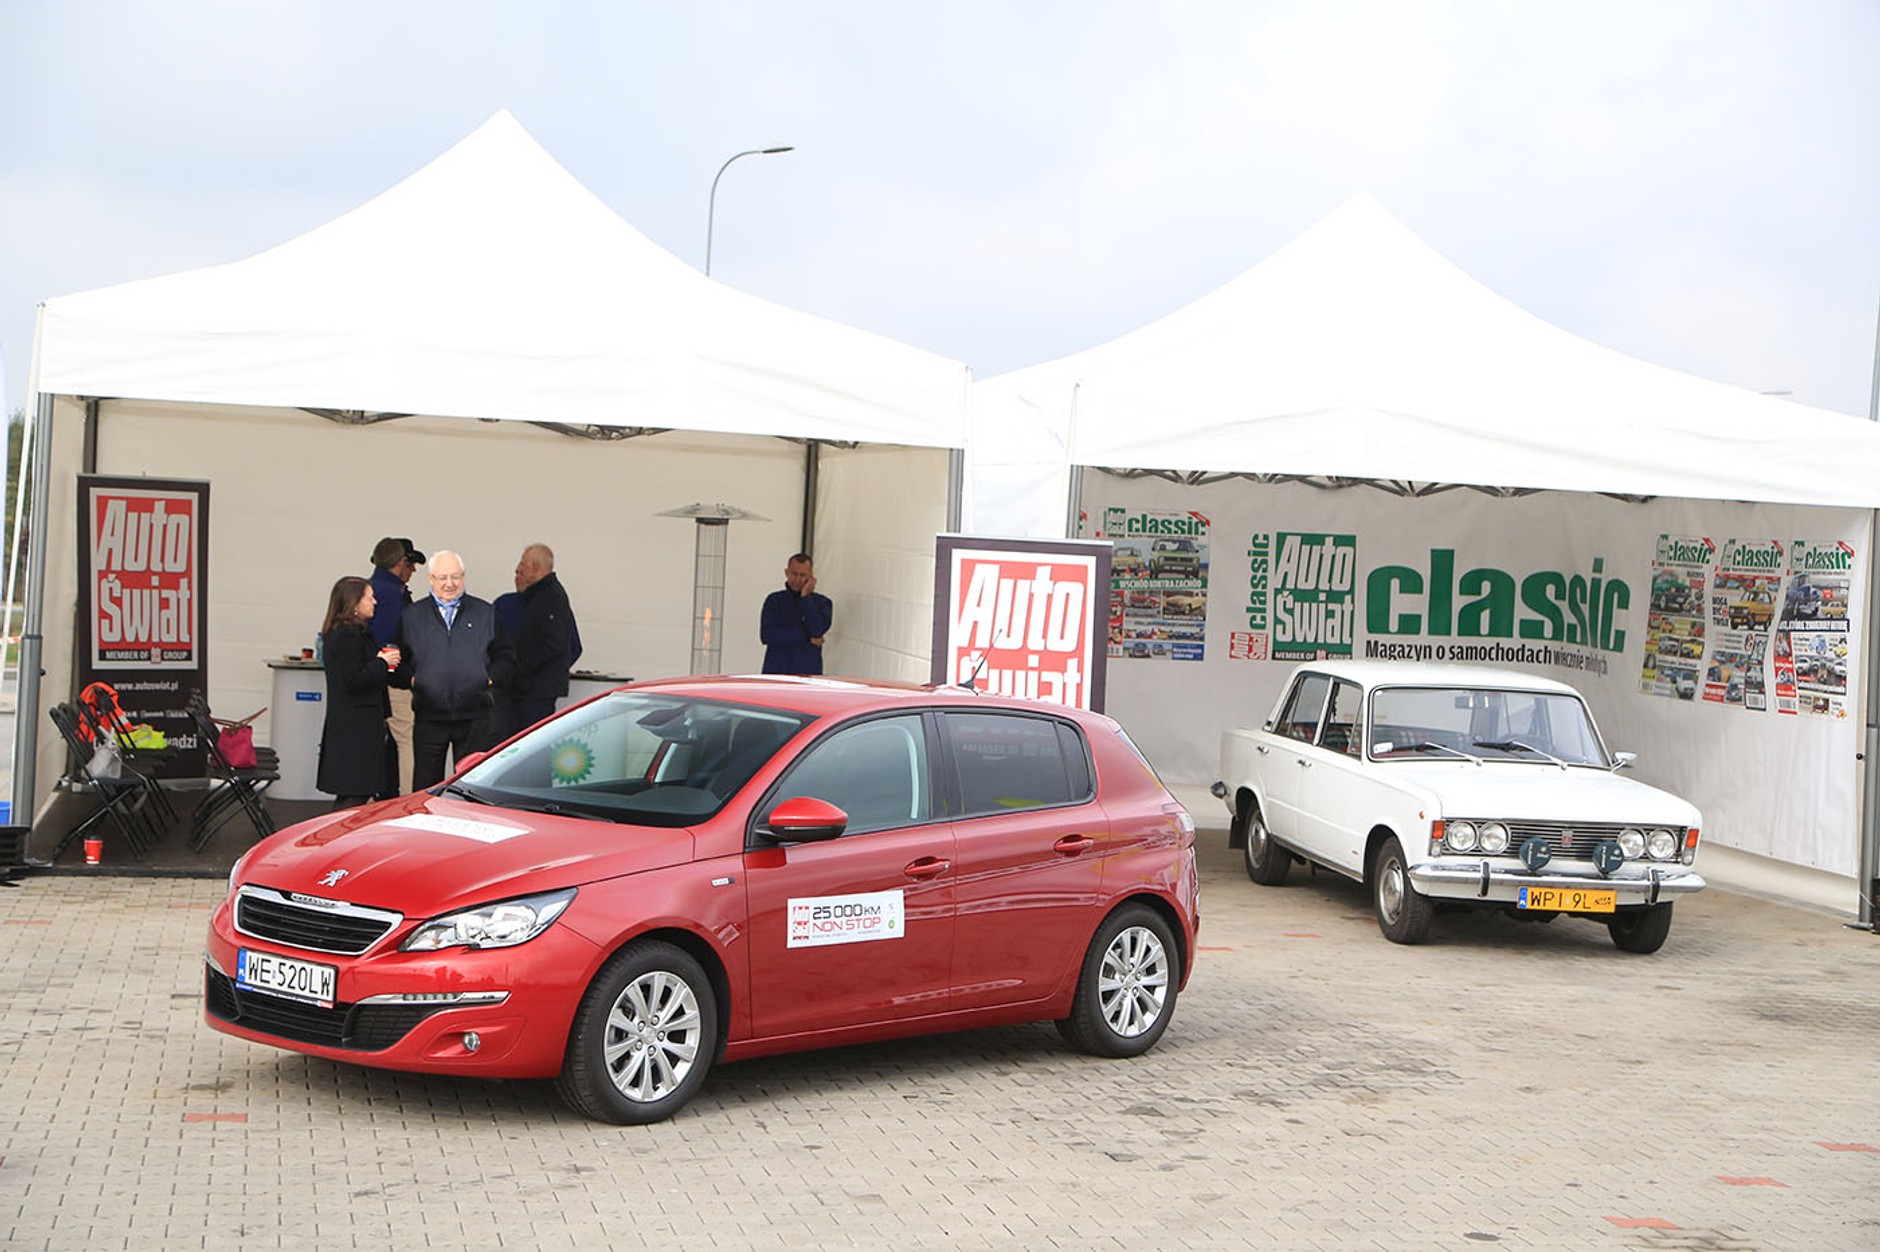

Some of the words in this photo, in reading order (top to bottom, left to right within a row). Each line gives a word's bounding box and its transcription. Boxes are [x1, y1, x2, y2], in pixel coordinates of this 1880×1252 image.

[97, 499, 190, 572] Auto
[1127, 514, 1206, 536] classic
[1274, 535, 1354, 591] Auto
[1667, 540, 1712, 564] classic
[1732, 544, 1781, 568] classic
[1804, 546, 1852, 570] classic
[1246, 533, 1269, 630] classic
[100, 573, 190, 643] Świat
[957, 563, 1085, 652] Auto
[1366, 548, 1630, 653] classic
[1275, 590, 1353, 645] Świat
[105, 650, 138, 660] MEMBER
[140, 651, 149, 659] OF
[163, 651, 188, 660] GROUP
[1275, 651, 1305, 660] MEMBER
[1306, 652, 1315, 660] OF
[1366, 640, 1432, 661] Magazyn
[1436, 645, 1446, 660] o
[1449, 642, 1551, 665] samochodach
[813, 905, 831, 920] 25
[813, 920, 842, 933] NON
[846, 917, 881, 931] STOP
[248, 955, 271, 984] WE
[277, 962, 332, 997] 520LW
